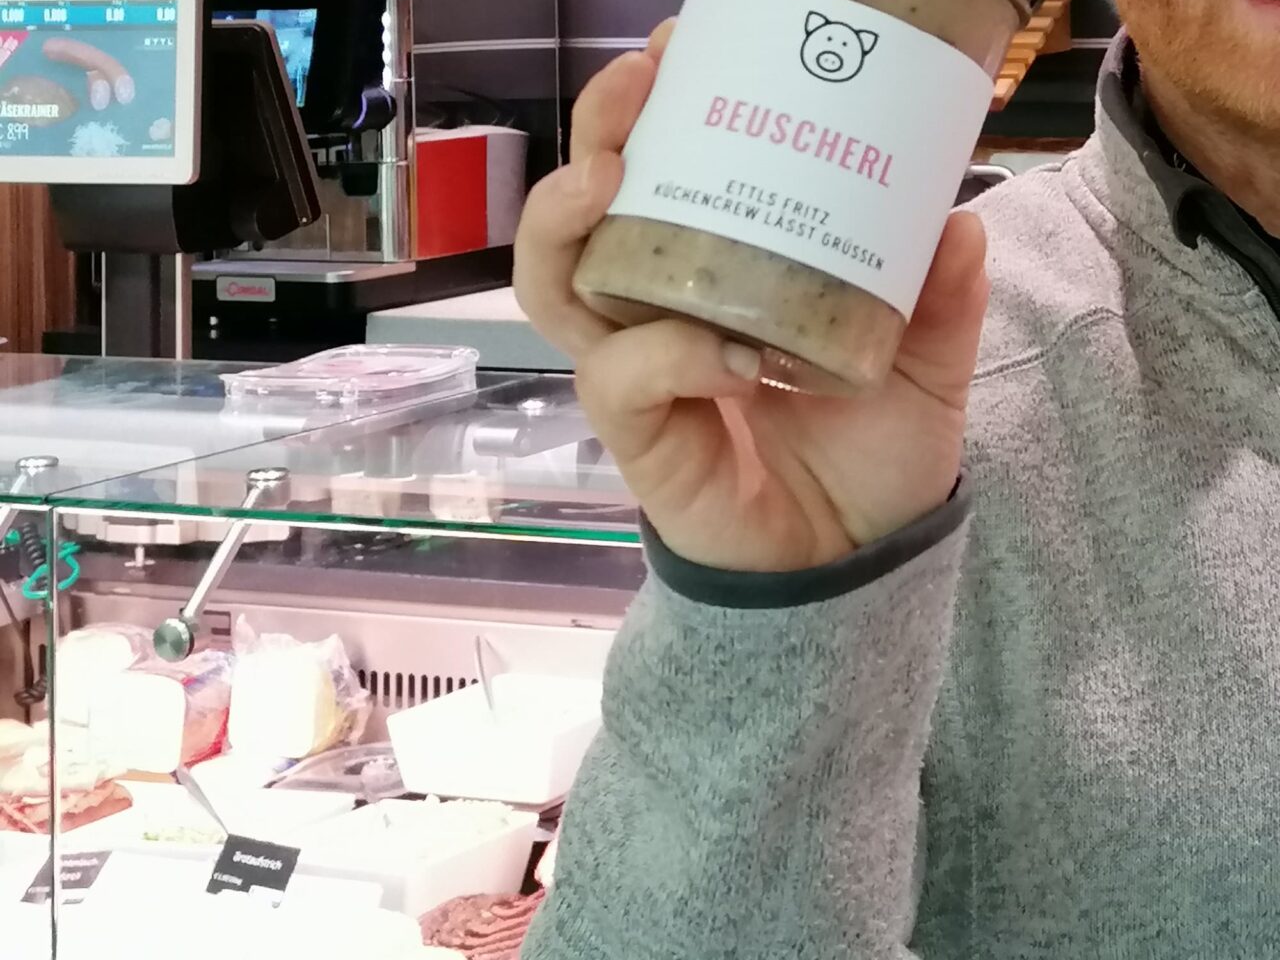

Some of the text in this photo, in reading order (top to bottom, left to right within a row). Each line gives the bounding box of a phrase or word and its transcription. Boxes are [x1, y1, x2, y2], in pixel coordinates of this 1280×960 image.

[0, 100, 60, 118] ÄSEKRAINER
[704, 95, 894, 188] BEUSCHERL
[654, 181, 885, 272] KÜCHENCREW LÄSST GRÜSSEN
[725, 178, 831, 227] ETTLS FRITZ
